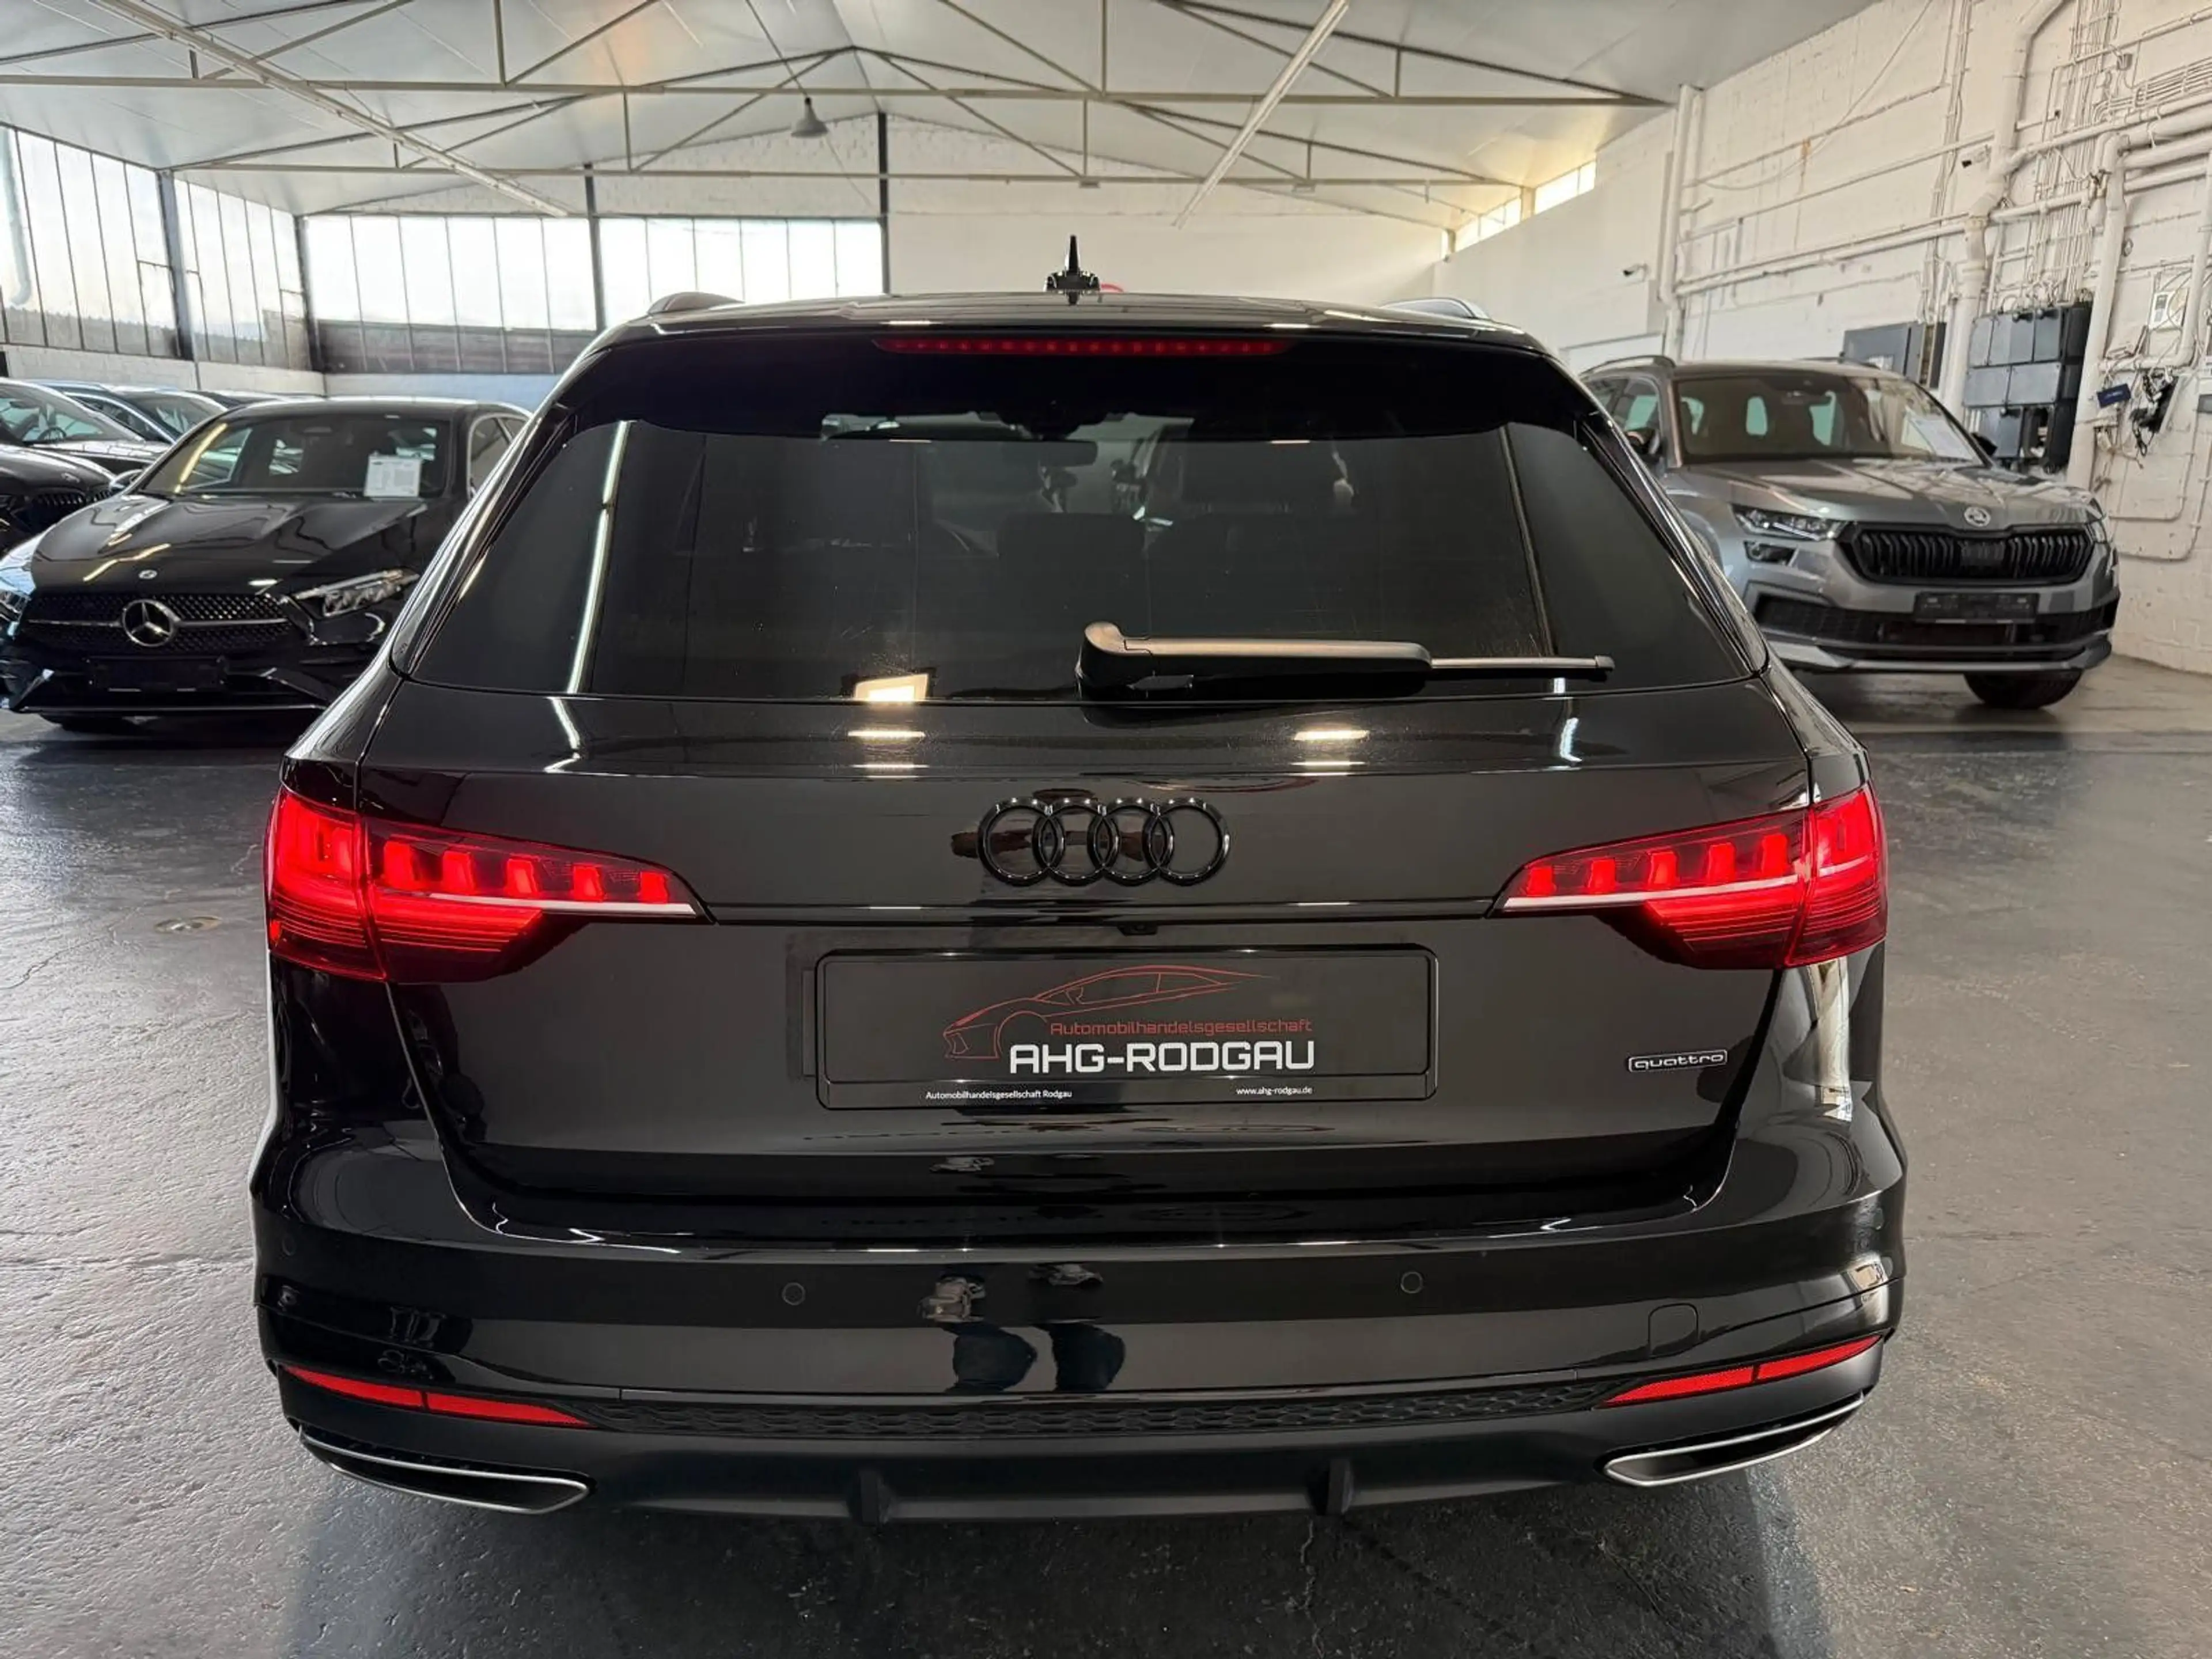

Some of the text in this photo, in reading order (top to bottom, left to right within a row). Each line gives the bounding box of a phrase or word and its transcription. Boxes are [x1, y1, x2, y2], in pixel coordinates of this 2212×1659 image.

[1050, 1018, 1312, 1037] Automobilhandelsgesellschaft
[1010, 1040, 1315, 1074] AHG-RODGAU
[1634, 1054, 1724, 1070] quattro
[926, 1089, 1072, 1100] Automobilhandelsgesellschaft Rodgau
[1236, 1086, 1313, 1096] www.ahg-rodgau.de
